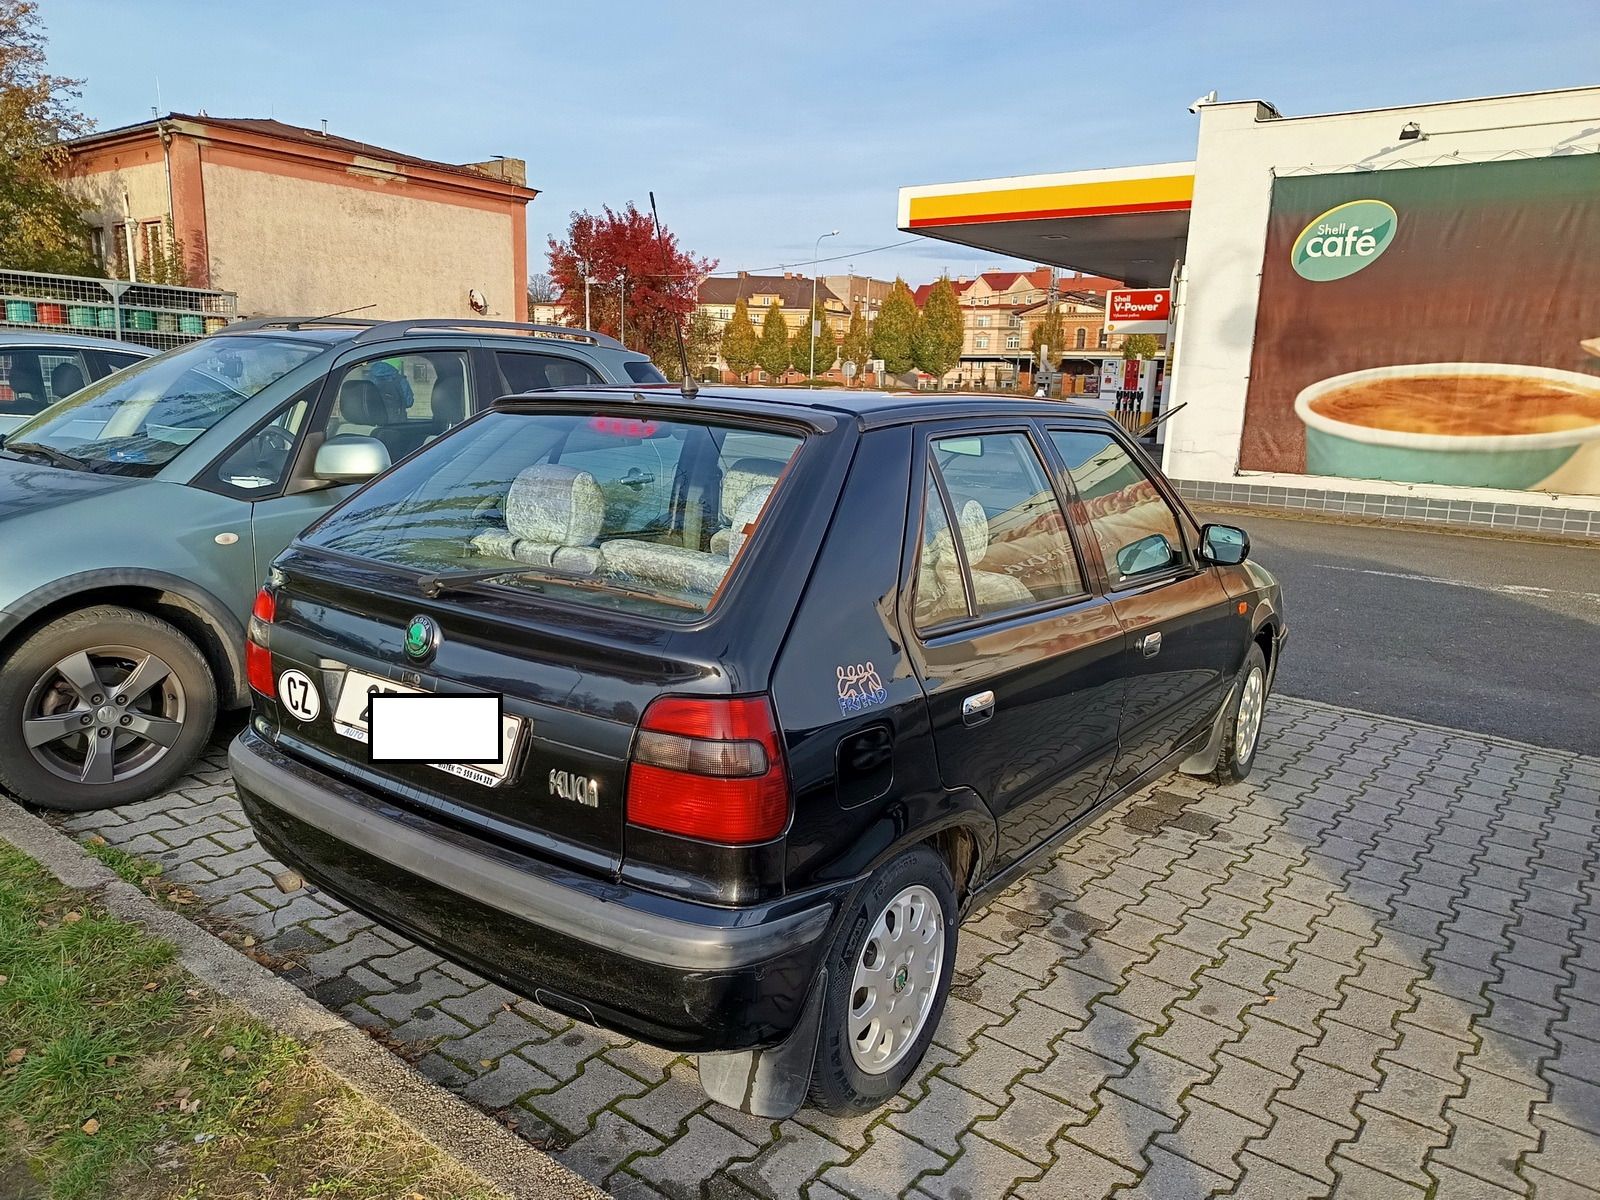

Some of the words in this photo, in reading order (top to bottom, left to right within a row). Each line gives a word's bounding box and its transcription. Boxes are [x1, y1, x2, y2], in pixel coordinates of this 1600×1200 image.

[1317, 223, 1345, 236] Shell
[1305, 226, 1377, 257] café
[1113, 294, 1131, 303] Shell
[1113, 302, 1159, 312] V-Power
[287, 675, 312, 716] CZ
[343, 727, 364, 740] AUTO
